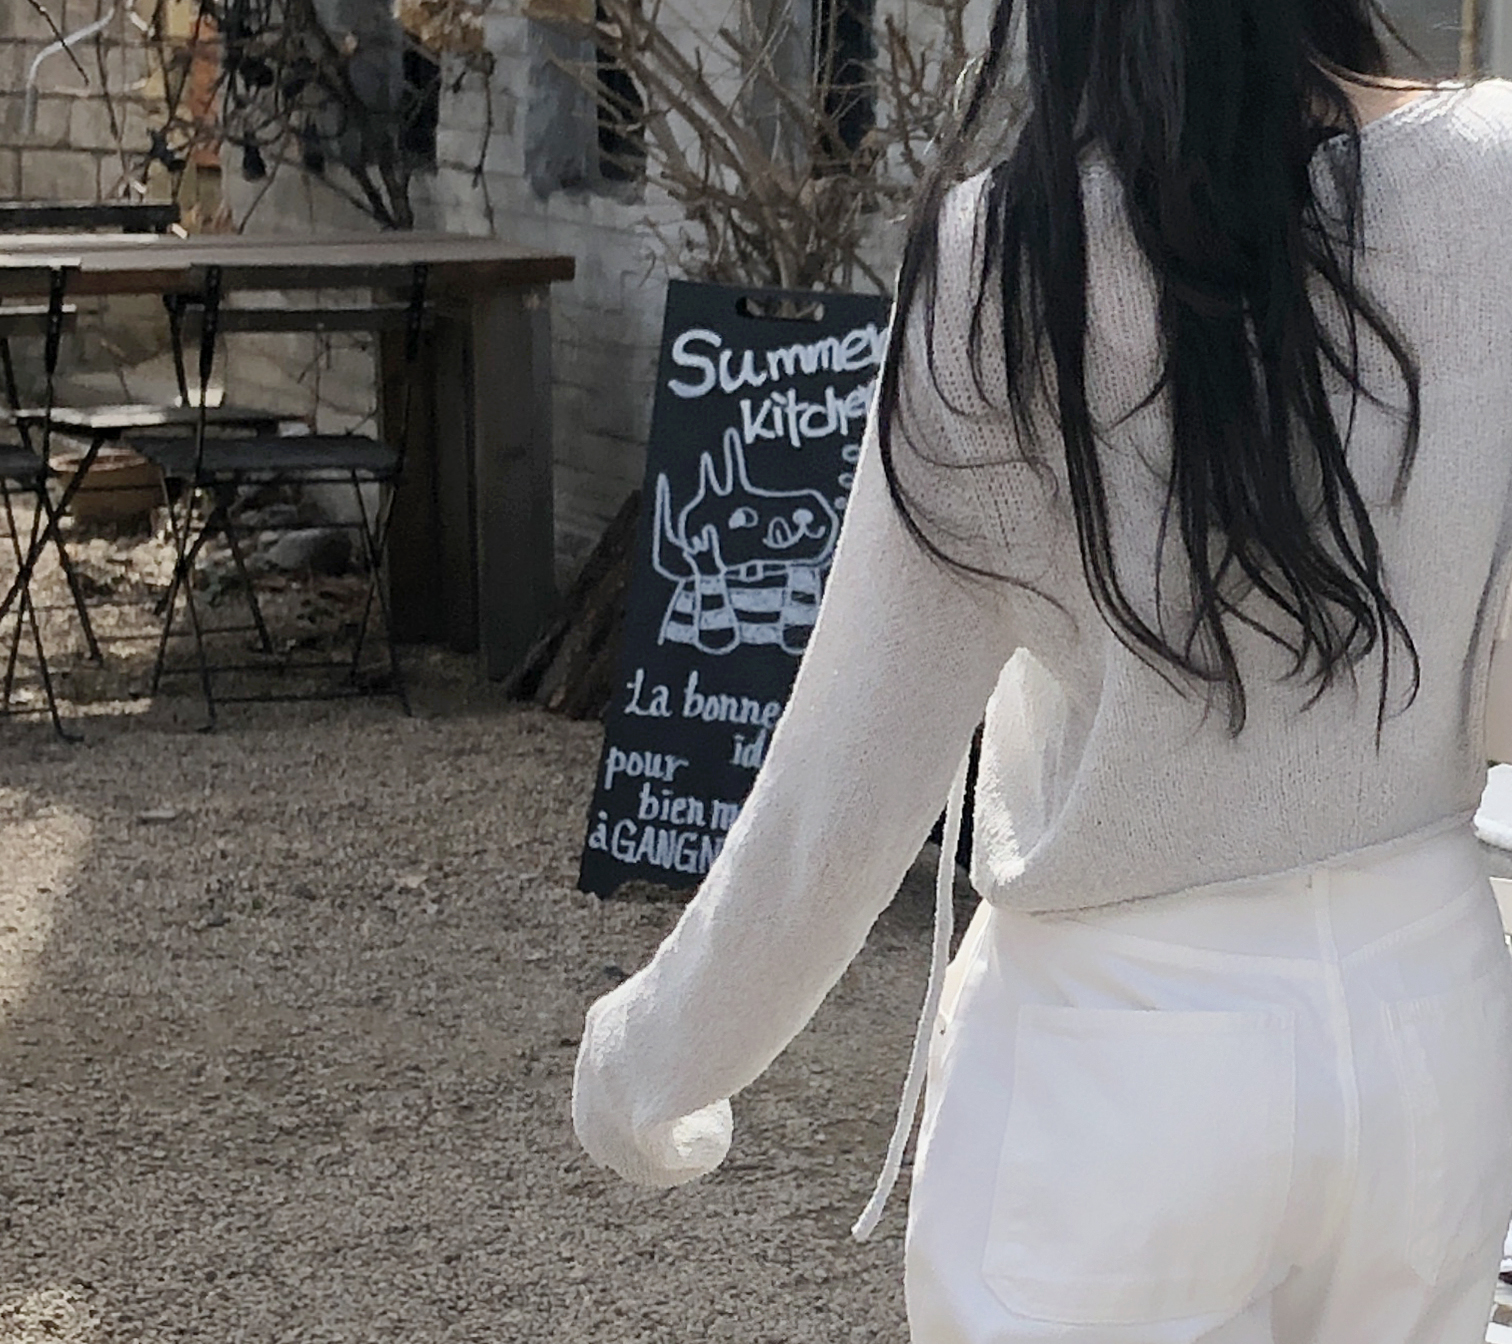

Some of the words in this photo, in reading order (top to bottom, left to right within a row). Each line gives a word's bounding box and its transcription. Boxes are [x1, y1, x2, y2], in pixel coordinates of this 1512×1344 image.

[623, 667, 673, 718] La
[681, 670, 783, 728] bonne
[604, 746, 690, 790] pour
[637, 781, 706, 827] bien
